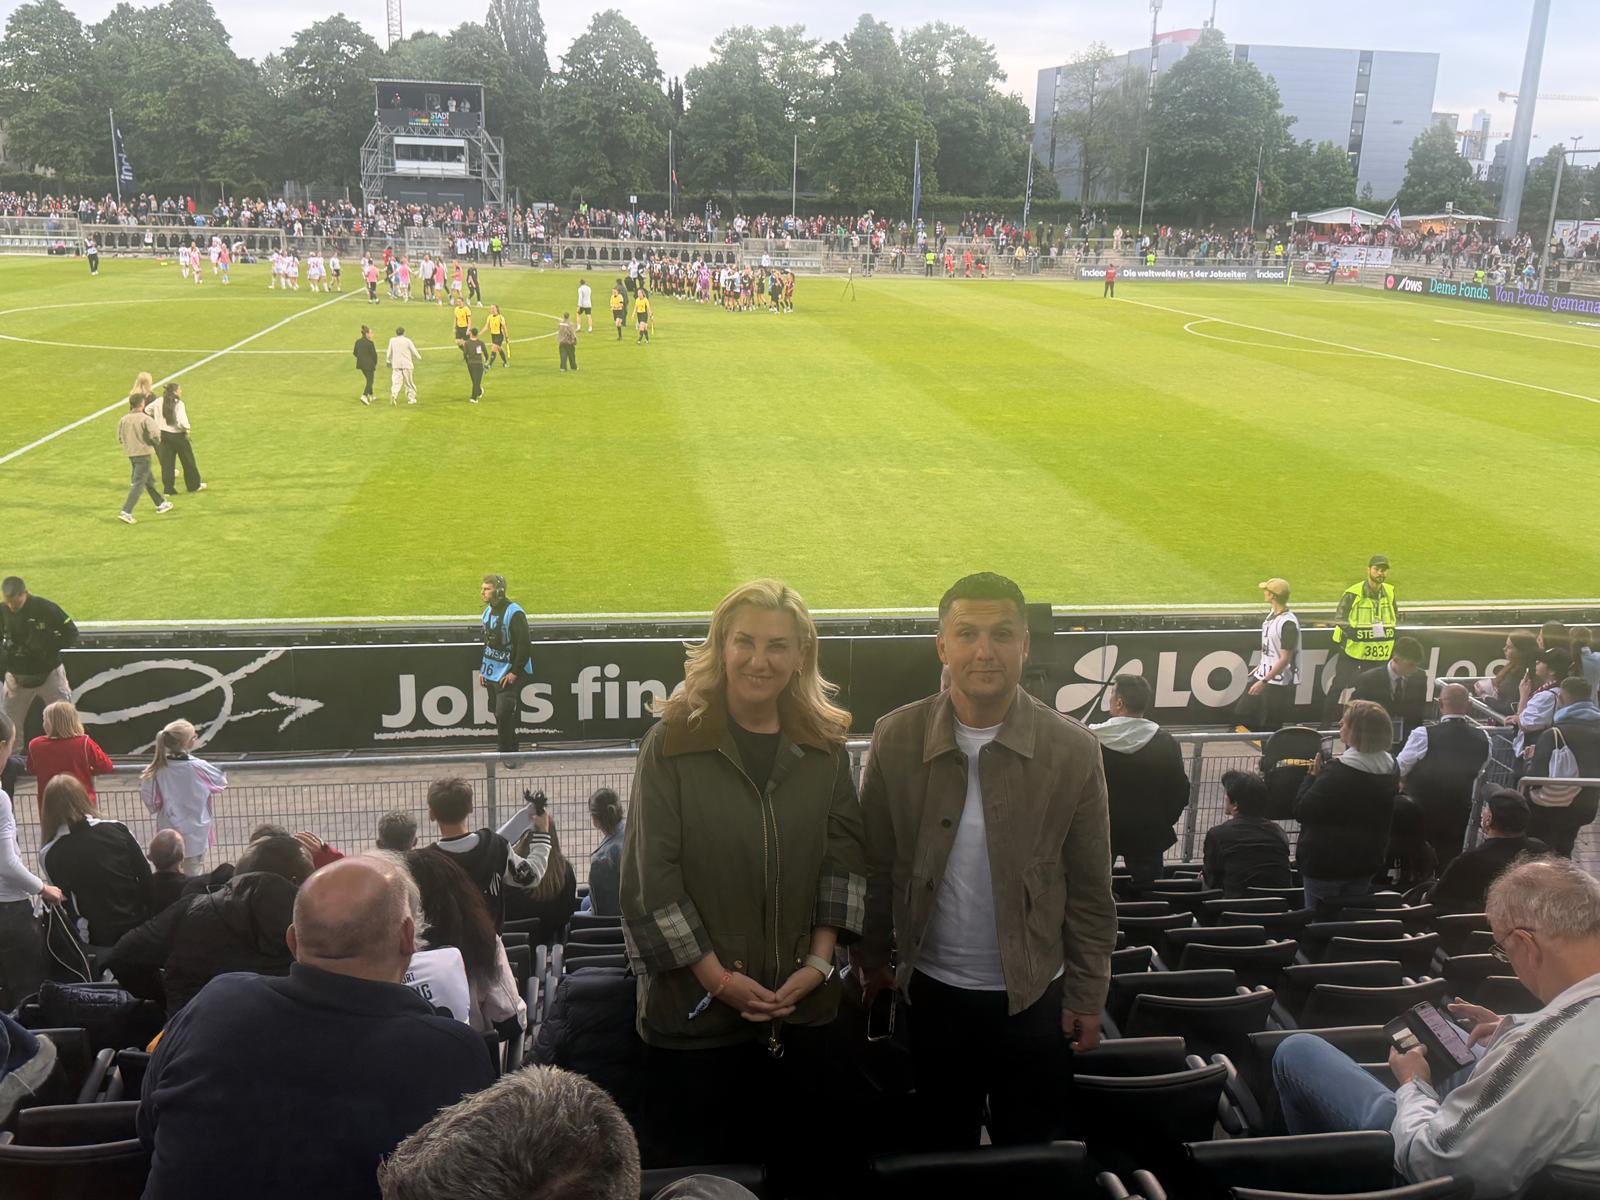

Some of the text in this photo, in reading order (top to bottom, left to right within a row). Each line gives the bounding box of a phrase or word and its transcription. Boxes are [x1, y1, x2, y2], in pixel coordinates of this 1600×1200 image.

[1123, 269, 1135, 277] Die
[1138, 269, 1175, 278] weltweite
[1177, 269, 1189, 278] Nr.
[1195, 270, 1209, 278] der
[1209, 270, 1247, 280] Jobseiten
[1256, 269, 1284, 279] indeed
[1405, 279, 1423, 292] DWS
[1430, 278, 1457, 295] Deine
[1458, 281, 1491, 300] Fonds.
[1495, 285, 1514, 304] Von
[1517, 286, 1549, 308] Profis
[1357, 628, 1394, 640] STERD
[1364, 645, 1390, 658] 3832
[1154, 650, 1355, 708] LOT
